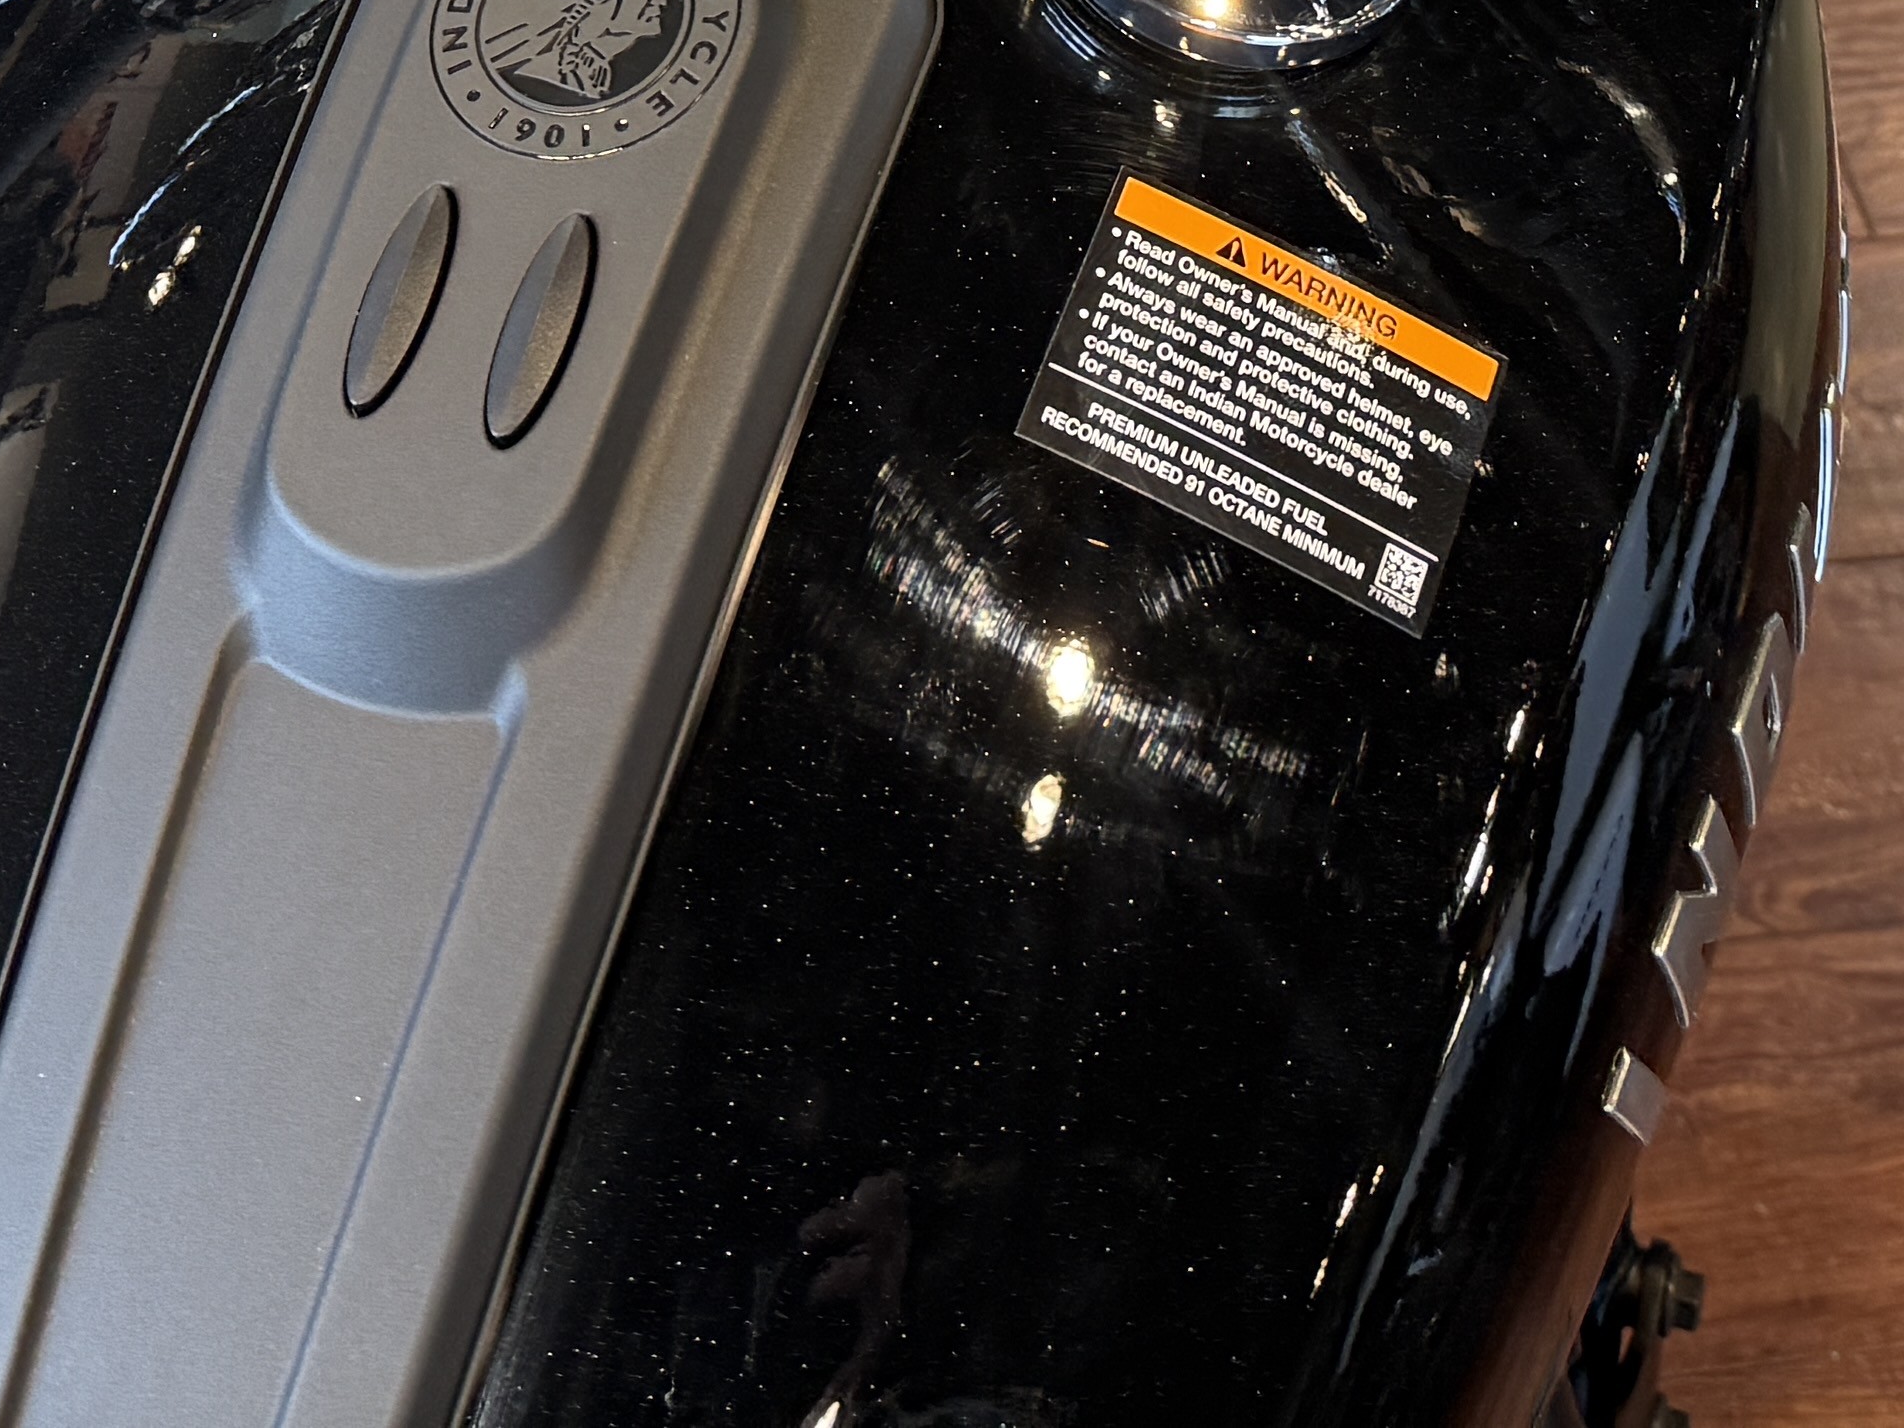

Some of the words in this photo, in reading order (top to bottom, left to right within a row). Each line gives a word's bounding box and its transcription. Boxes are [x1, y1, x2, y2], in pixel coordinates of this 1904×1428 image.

[487, 106, 592, 148] 1901
[1099, 293, 1197, 346] protection
[1199, 339, 1238, 367] and
[1238, 359, 1334, 416] protective
[1336, 408, 1414, 460] clothing.
[1108, 272, 1175, 314] Always
[1181, 306, 1227, 338] wear
[1228, 330, 1253, 352] an
[1256, 344, 1346, 399] approved
[1347, 387, 1414, 438] helmet,
[1419, 429, 1453, 456] eye
[1117, 249, 1175, 286] follow
[1176, 280, 1201, 299] all
[1203, 293, 1260, 331] safety
[1261, 320, 1374, 389] precautions.
[1125, 230, 1176, 265] Read
[1178, 256, 1253, 303] Owner's
[1256, 293, 1327, 339] Manual
[1372, 351, 1431, 398] during
[1434, 388, 1471, 420] use,
[1261, 251, 1398, 340] WARNING
[1078, 351, 1108, 376] for
[1108, 368, 1122, 385] a
[1125, 379, 1247, 446] replacement.
[1084, 334, 1157, 378] contact
[1159, 369, 1185, 391] an
[1188, 379, 1246, 421] Indian
[1249, 410, 1354, 477] Motorcycle
[1358, 469, 1418, 510] dealer
[1087, 402, 1179, 457] PREMIUM
[1180, 446, 1280, 508] UNLEADED
[1282, 498, 1328, 536] FUEL
[1092, 312, 1110, 331] If
[1108, 323, 1154, 351] your
[1156, 342, 1232, 390] Owner's
[1236, 380, 1307, 428] Manual
[1308, 417, 1325, 438] is
[1328, 431, 1403, 483] missing,
[1041, 406, 1183, 484] RECOMMENDED
[1185, 474, 1205, 496] 91
[1208, 487, 1283, 536] OCTANE
[1282, 524, 1366, 580] MINIMUM
